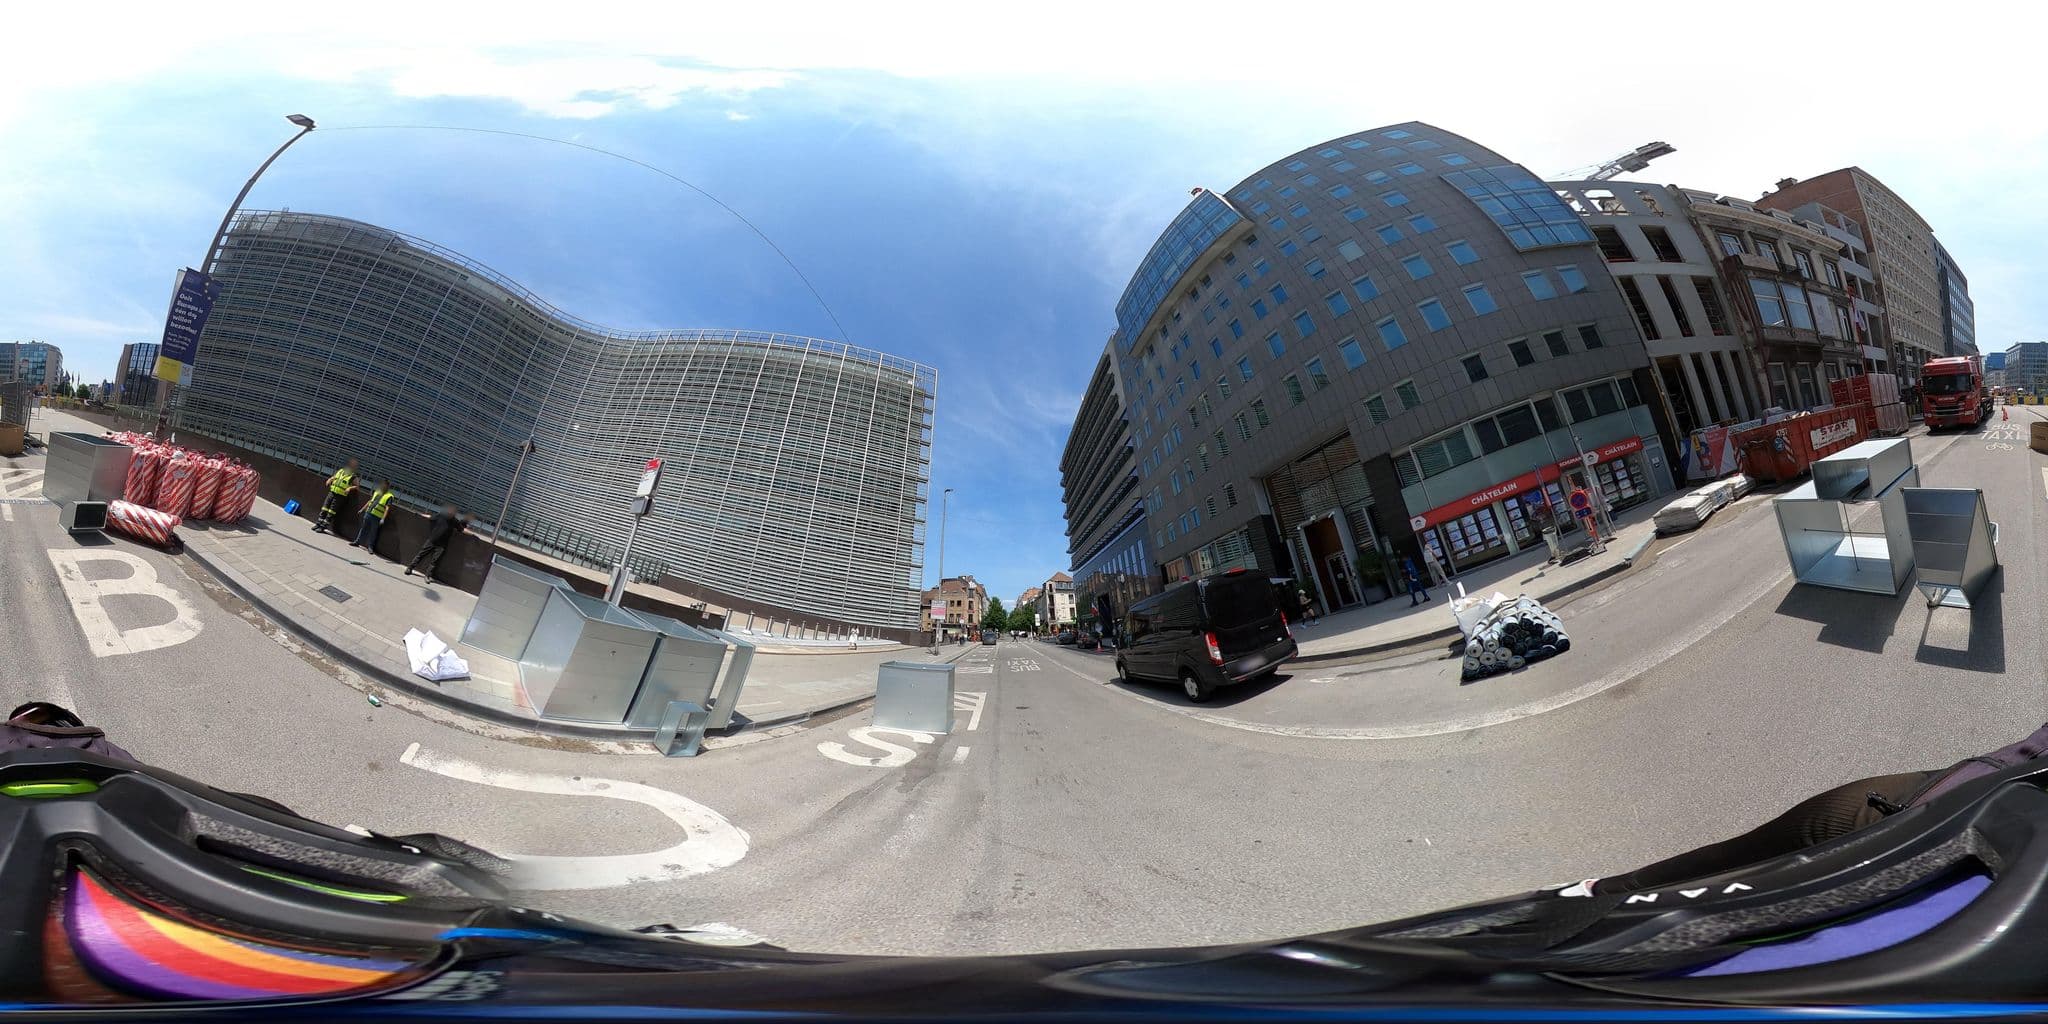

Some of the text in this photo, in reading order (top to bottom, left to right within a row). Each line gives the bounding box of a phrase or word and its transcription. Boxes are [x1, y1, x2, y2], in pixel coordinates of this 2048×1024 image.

[1820, 421, 1850, 436] STAR
[1981, 430, 2020, 440] TAXI
[1471, 482, 1518, 506] CHÂTELAIN
